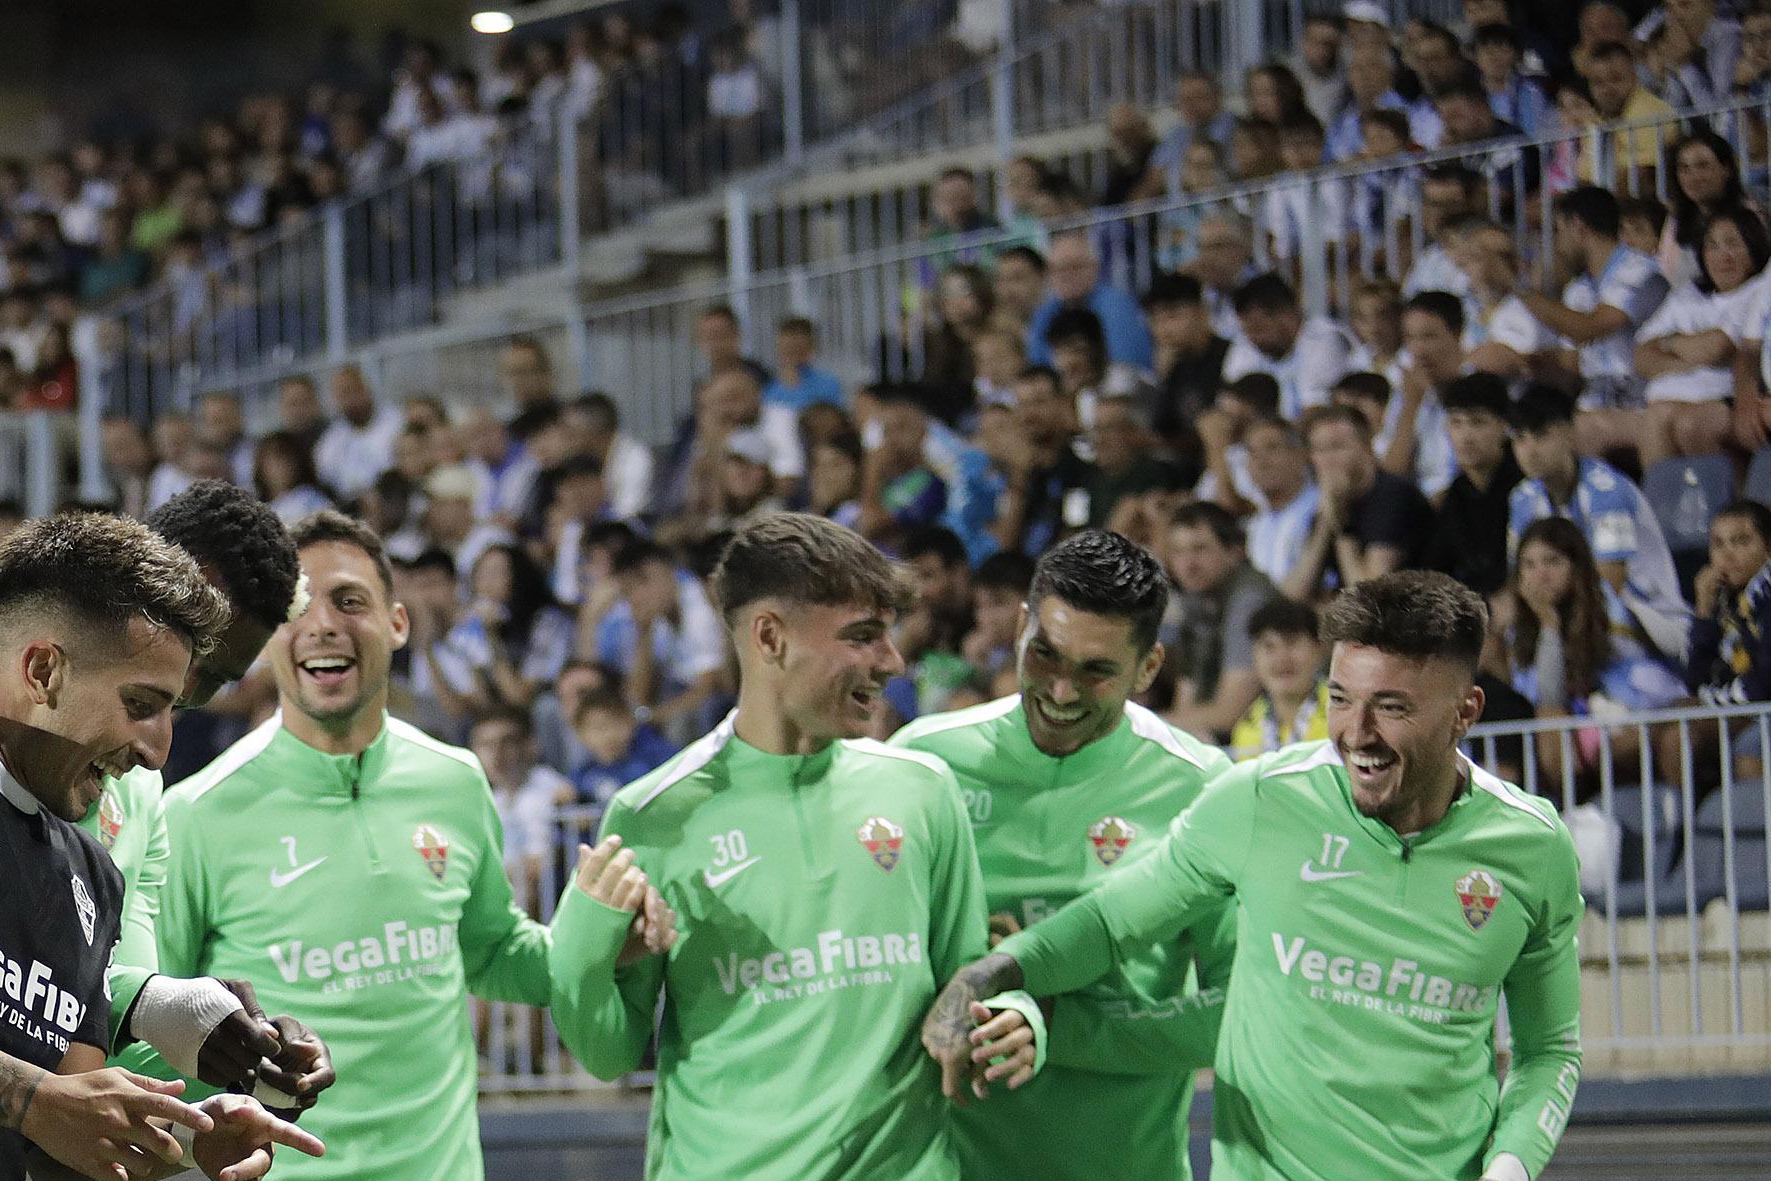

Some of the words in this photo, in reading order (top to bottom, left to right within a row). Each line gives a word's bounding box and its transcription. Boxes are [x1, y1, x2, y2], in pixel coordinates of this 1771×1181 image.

[279, 836, 297, 867] 7
[709, 829, 748, 867] 30
[1321, 833, 1350, 868] 17
[345, 974, 373, 991] REY
[376, 970, 395, 985] DE
[1310, 985, 1327, 1000] EL
[1332, 989, 1362, 1008] REY
[8, 1009, 25, 1031] DE
[26, 1020, 43, 1042] LA
